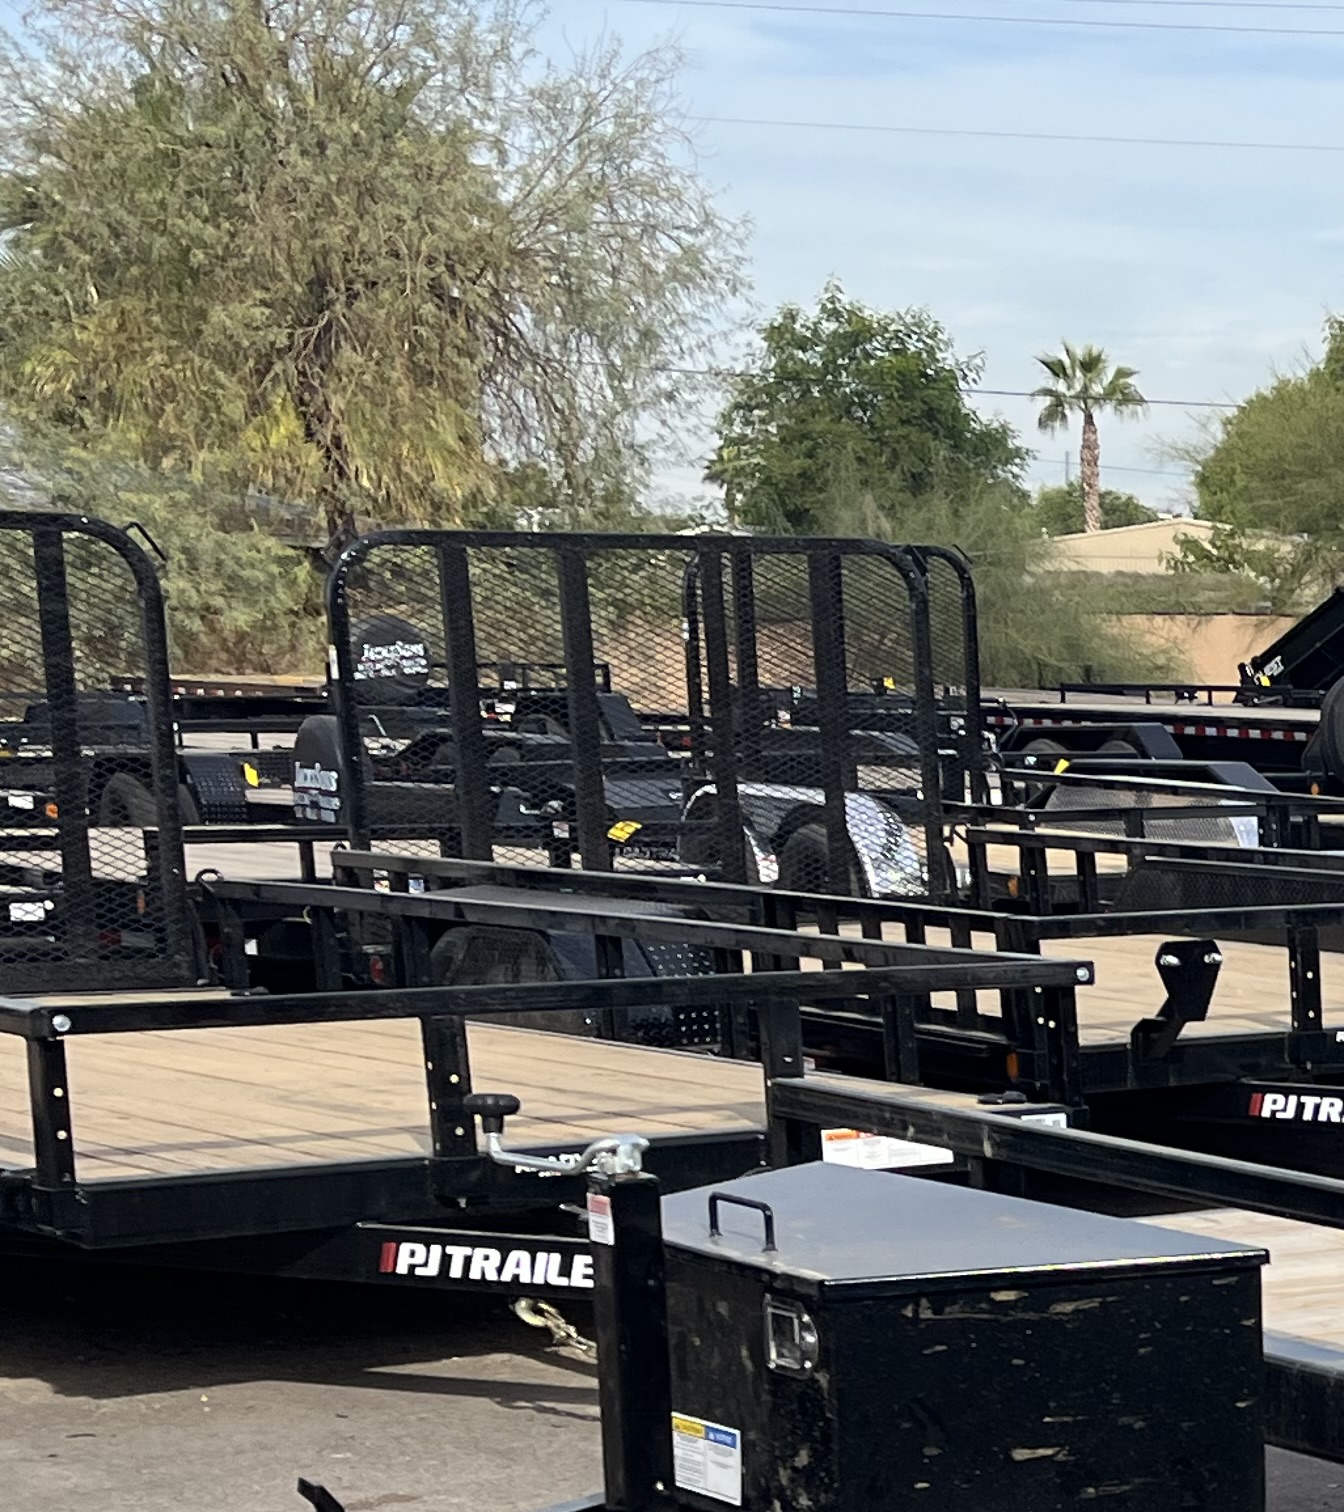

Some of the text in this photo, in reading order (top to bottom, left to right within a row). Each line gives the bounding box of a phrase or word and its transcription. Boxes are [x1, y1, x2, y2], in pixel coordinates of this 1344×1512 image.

[1260, 1092, 1298, 1120] PJ
[394, 1241, 595, 1289] PJ TRAILE
